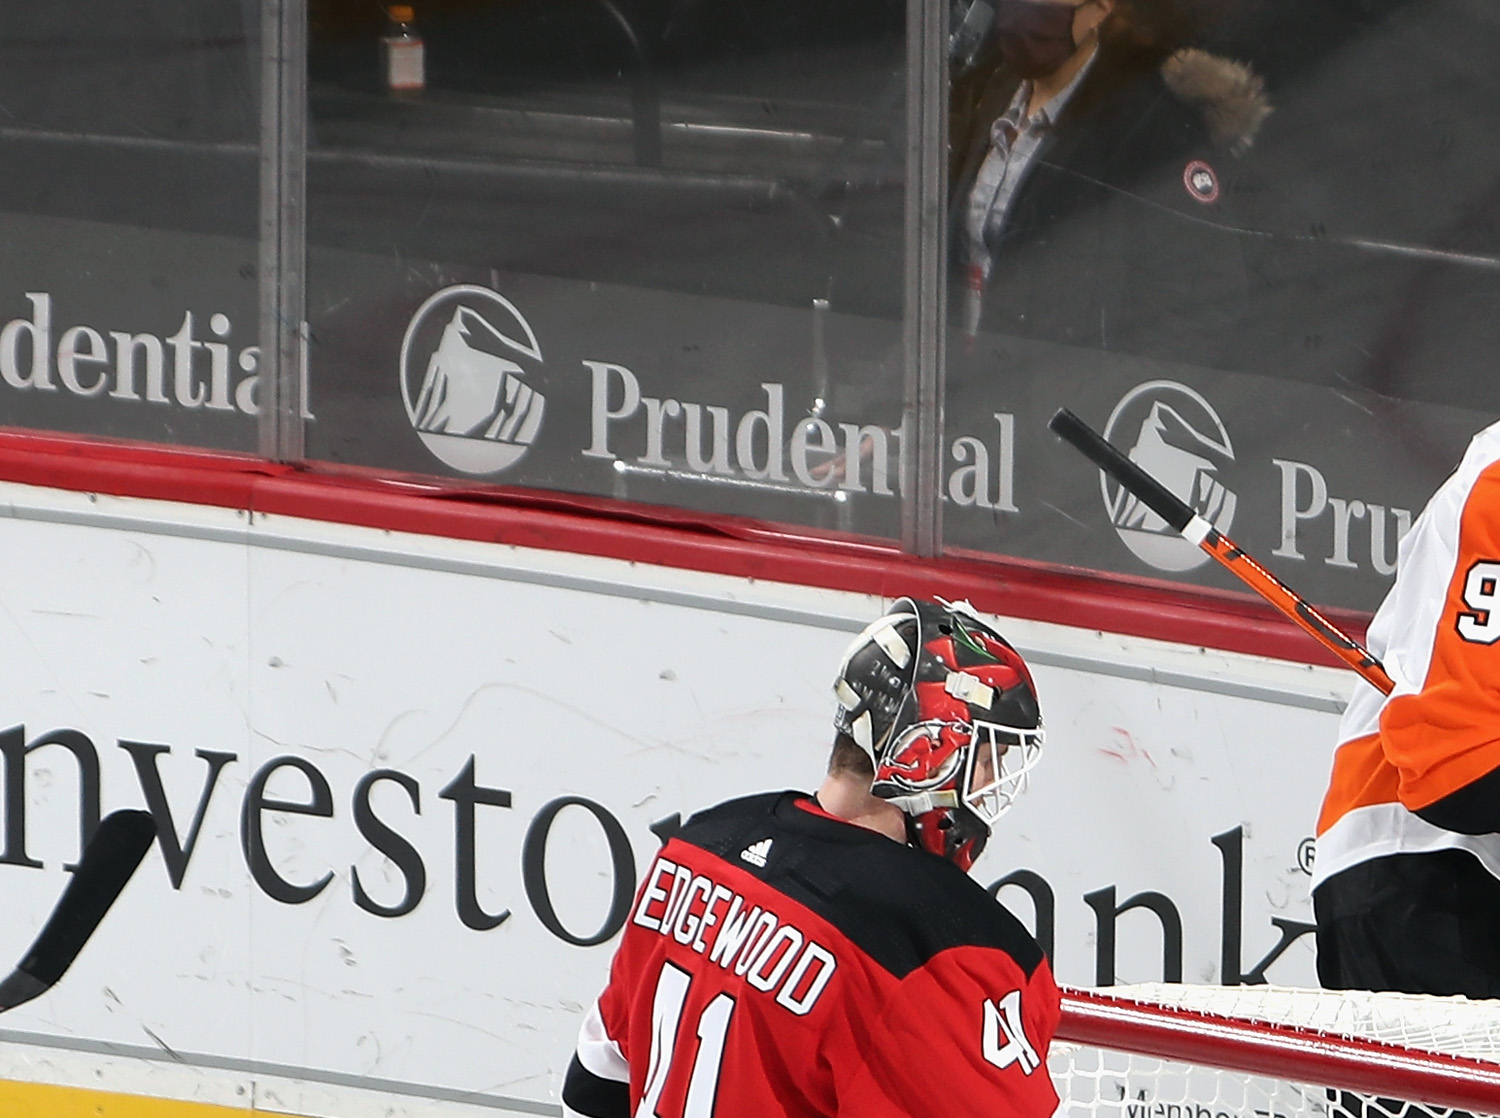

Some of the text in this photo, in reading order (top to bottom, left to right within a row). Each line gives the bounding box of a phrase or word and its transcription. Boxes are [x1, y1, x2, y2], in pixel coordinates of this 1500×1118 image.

[581, 359, 1019, 513] Prudenal
[0, 723, 683, 947] nvesto
[632, 856, 838, 1016] EDGEWOOD
[981, 988, 1042, 1077] 41
